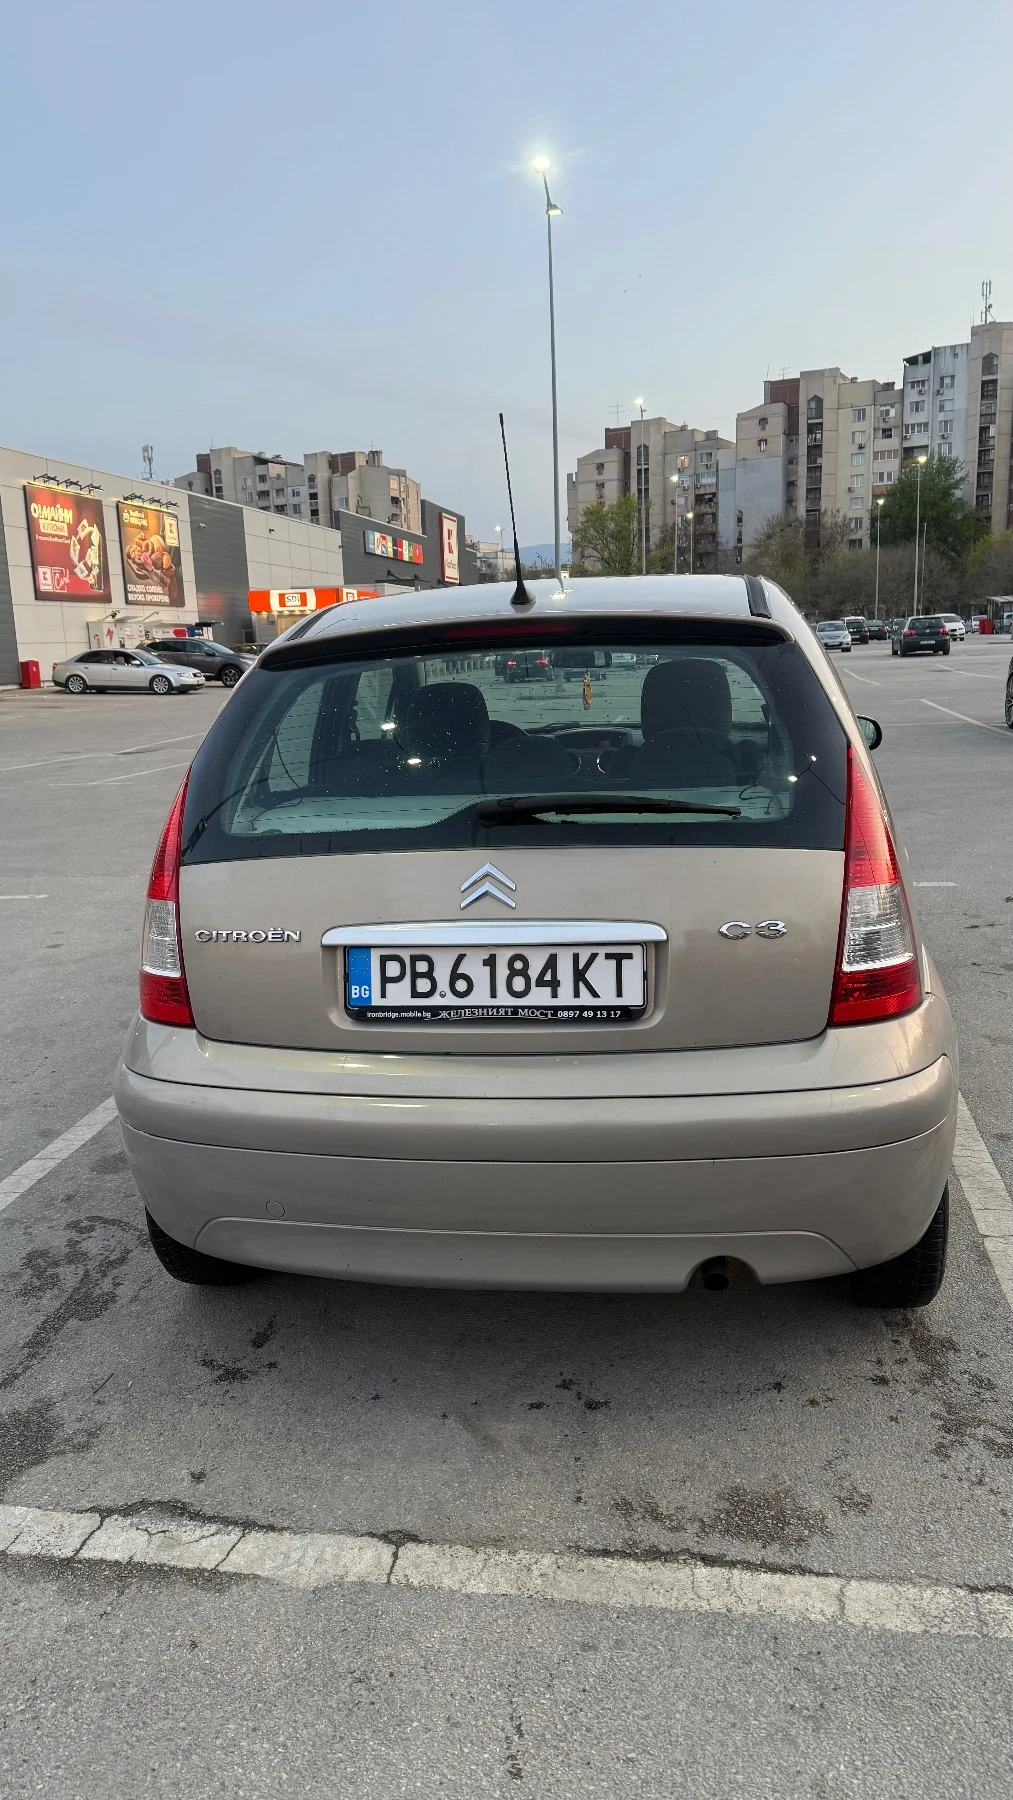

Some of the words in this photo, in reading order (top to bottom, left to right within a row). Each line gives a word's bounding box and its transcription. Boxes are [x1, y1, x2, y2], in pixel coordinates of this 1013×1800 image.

[41, 522, 66, 533] КУПОНИ
[55, 568, 70, 589] Card
[195, 927, 302, 942] CITROËN
[718, 920, 788, 940] C3
[351, 985, 370, 998] BG
[366, 1011, 431, 1019] ironbridge.mobile.bg
[438, 1007, 515, 1019] ЖЕЛЕЗНИЯТ
[517, 1008, 554, 1018] МОСТ
[557, 1010, 580, 1019] 0897
[582, 1010, 594, 1019] 49
[596, 1010, 607, 1019] 13
[609, 1010, 621, 1019] 17
